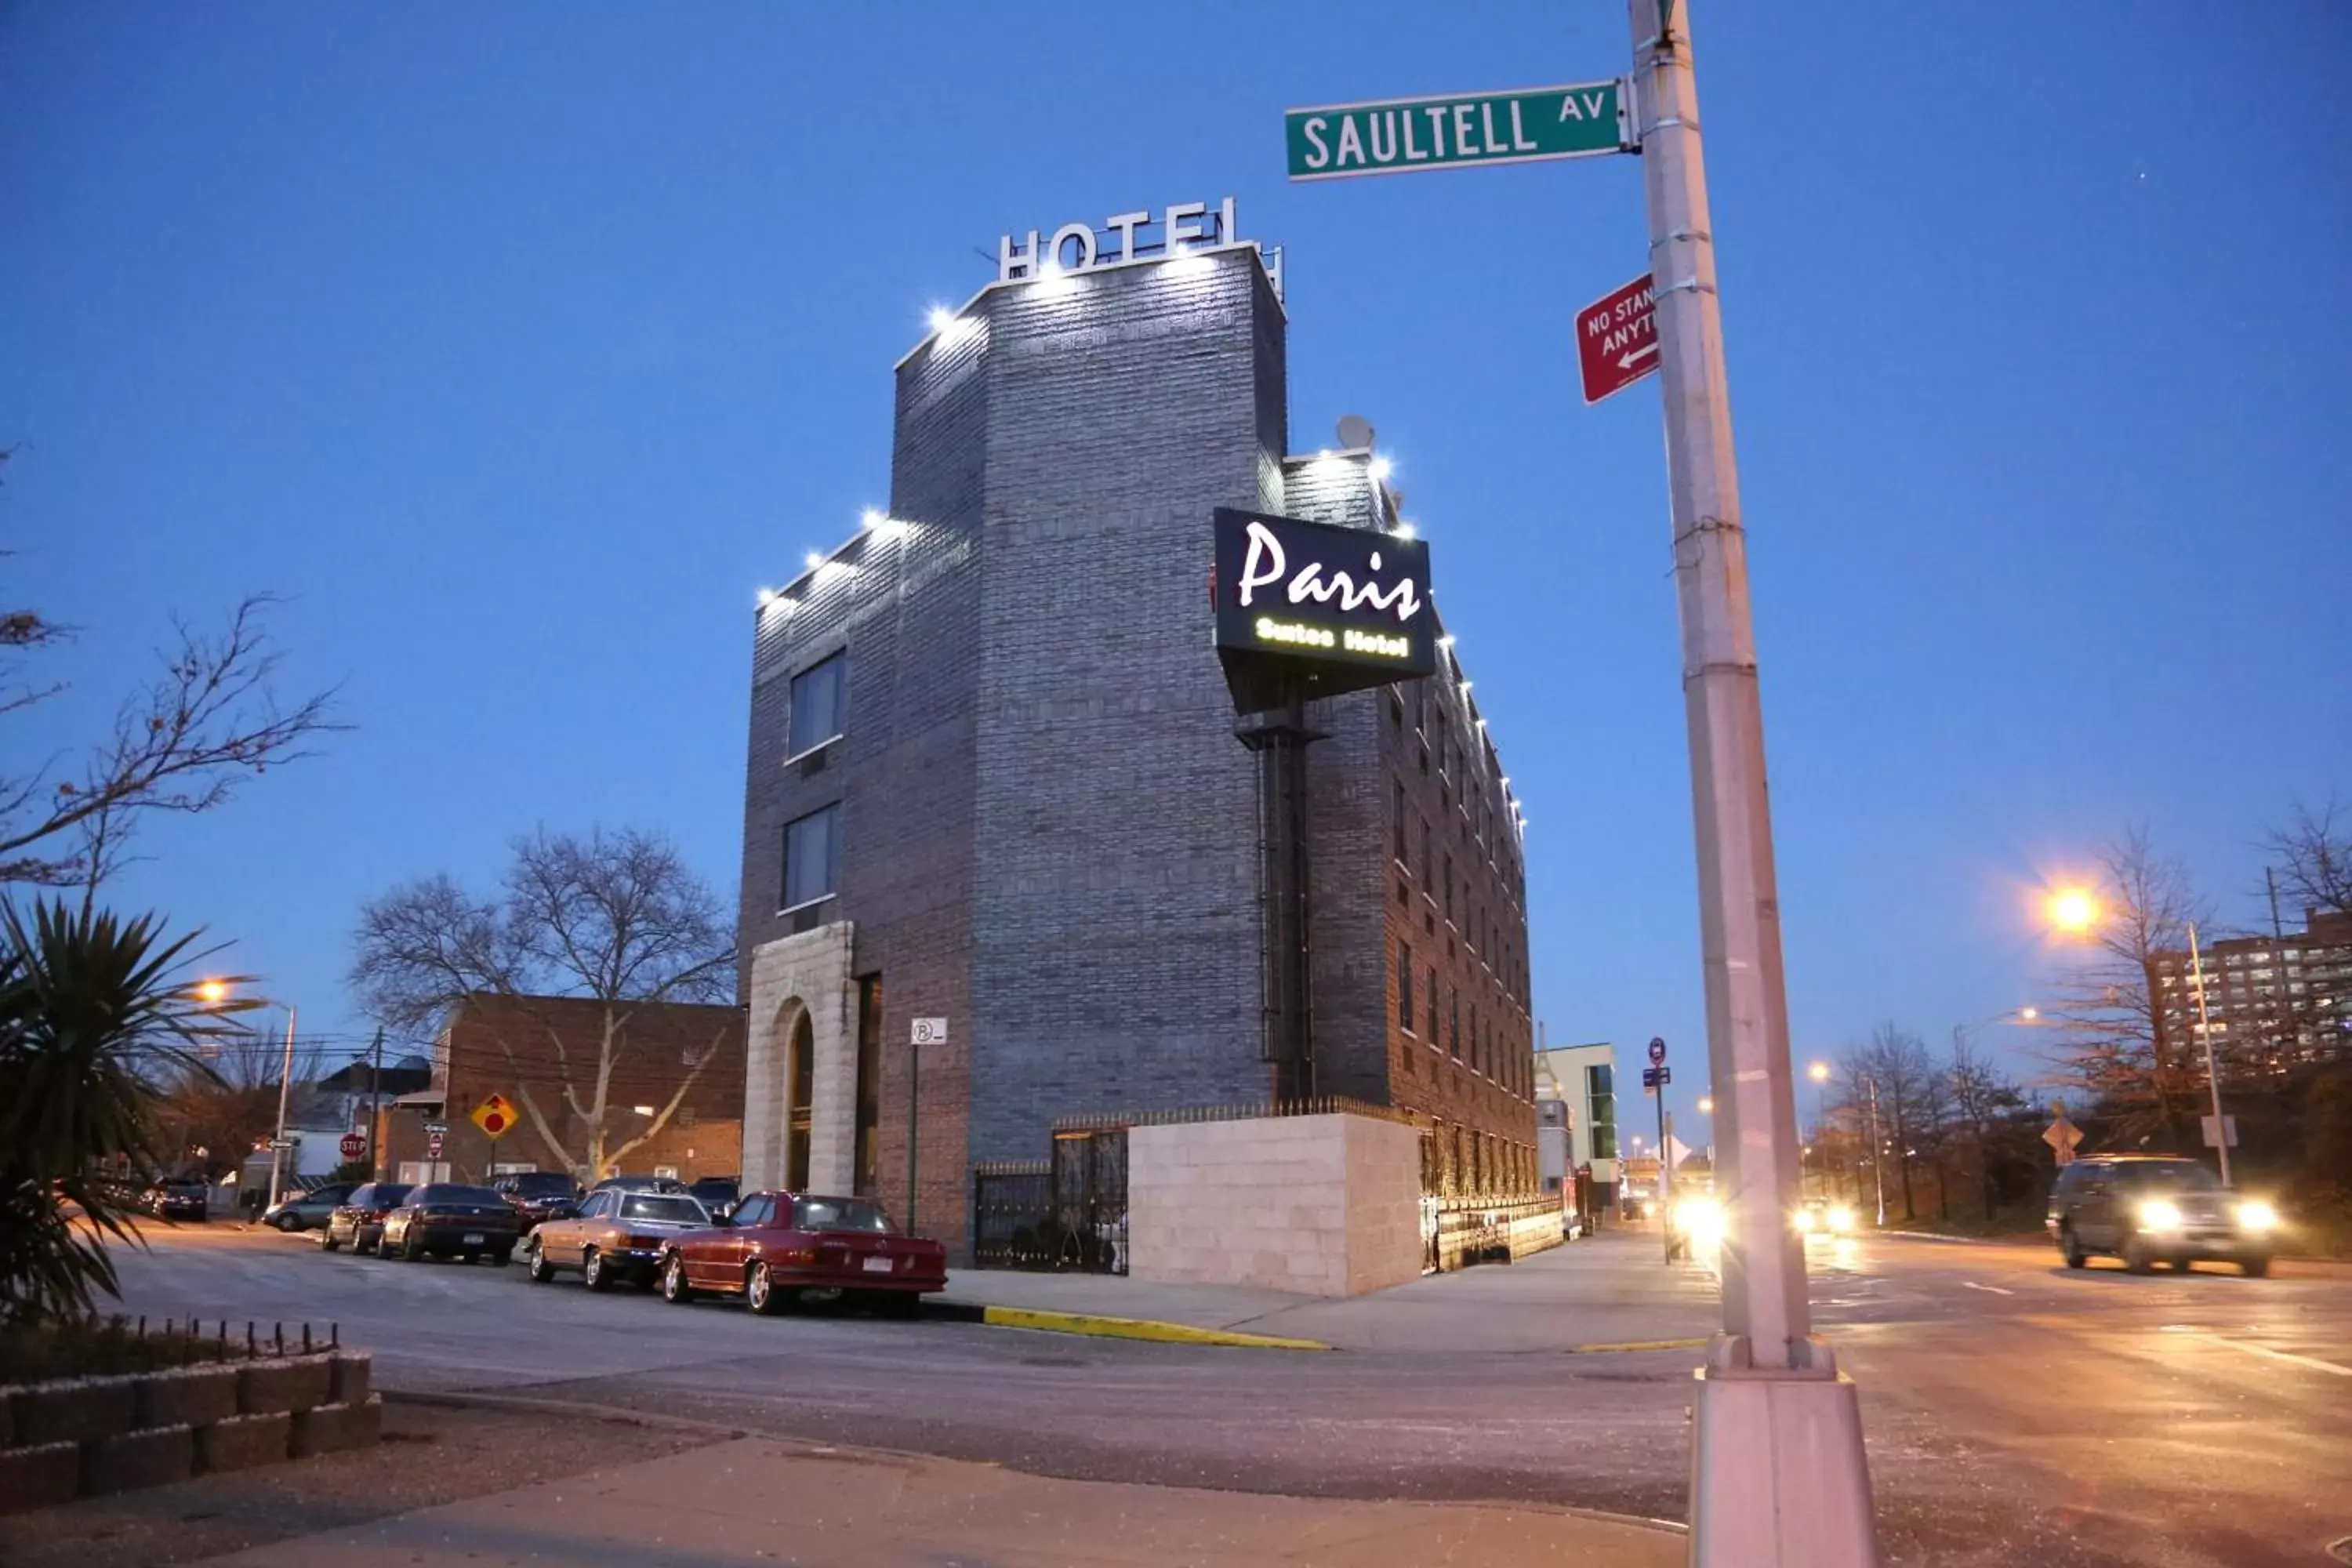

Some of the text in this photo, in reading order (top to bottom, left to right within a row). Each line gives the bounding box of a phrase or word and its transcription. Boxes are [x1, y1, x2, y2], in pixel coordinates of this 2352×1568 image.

[1304, 92, 1604, 168] SAULTELL AV
[1000, 197, 1261, 282] HOTEL
[1588, 311, 1610, 337] NO
[1239, 521, 1421, 621] Paris
[1344, 630, 1409, 657] Hotel
